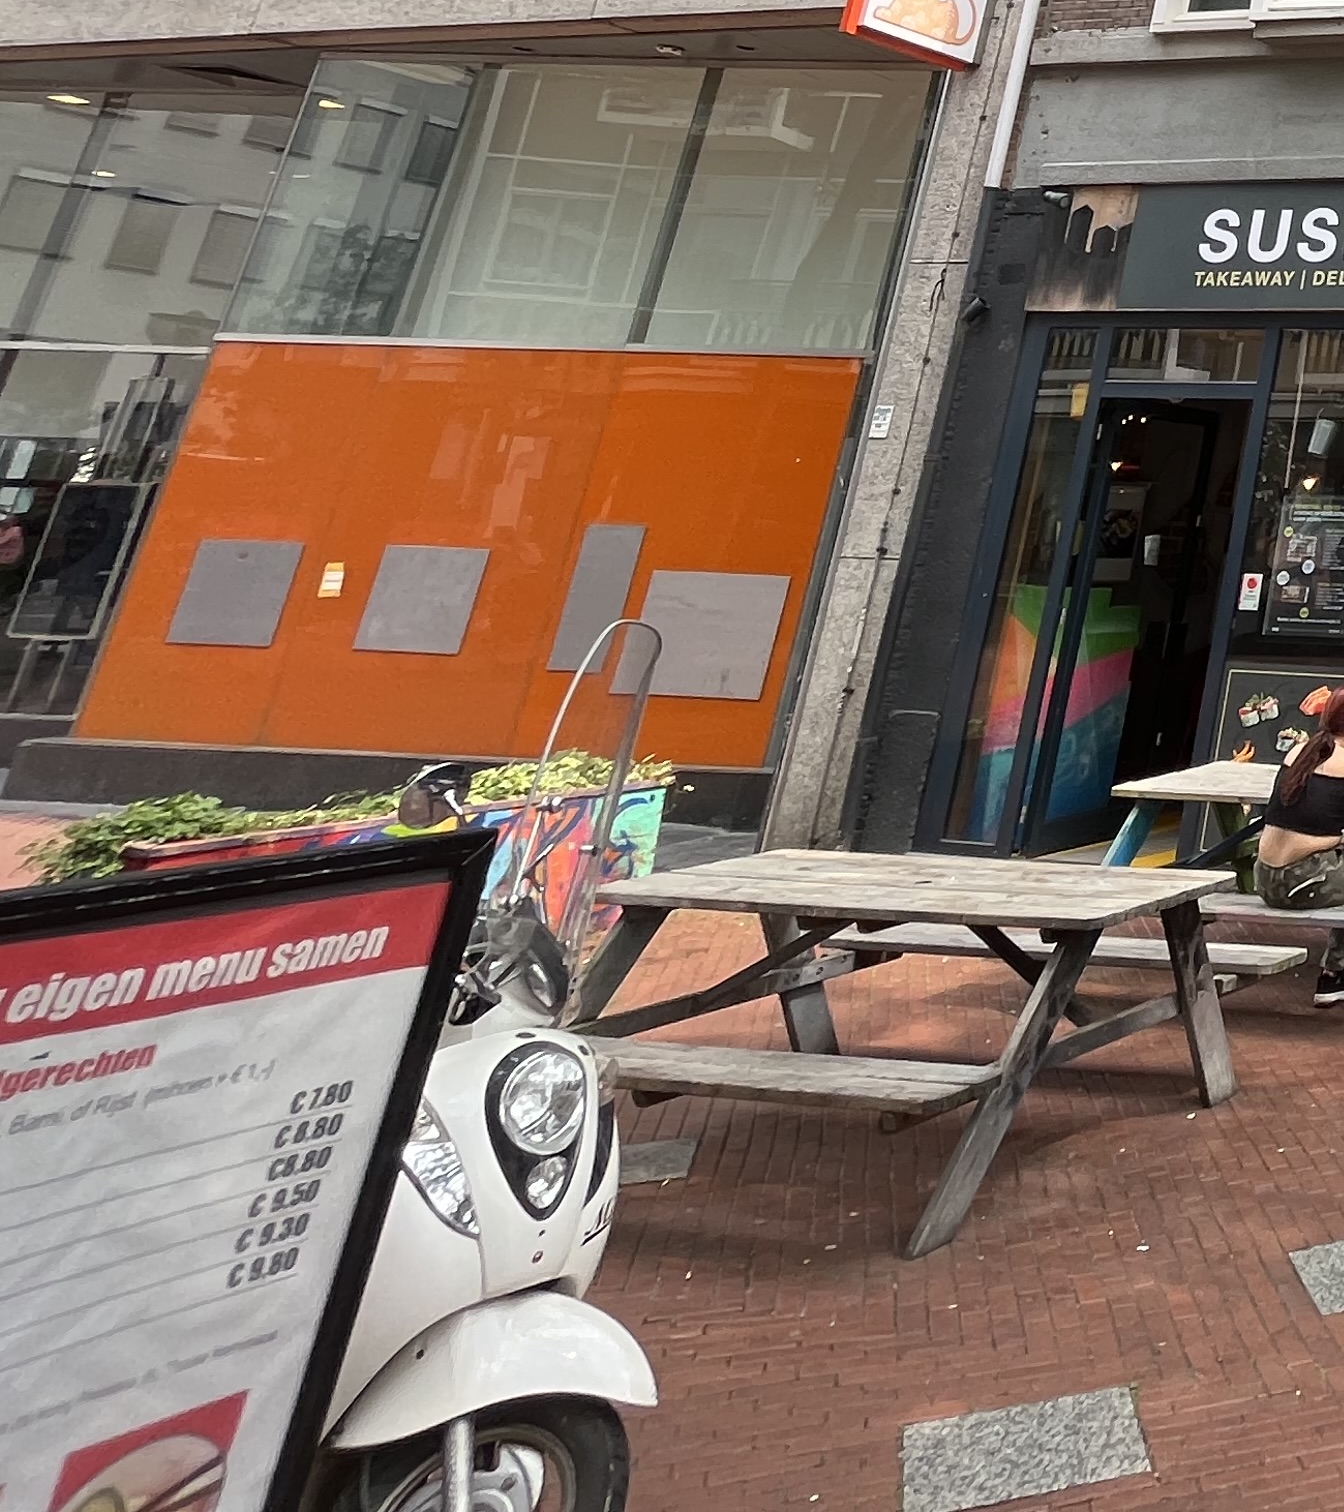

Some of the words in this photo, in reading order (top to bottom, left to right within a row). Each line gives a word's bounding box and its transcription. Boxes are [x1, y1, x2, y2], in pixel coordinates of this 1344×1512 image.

[1194, 270, 1296, 287] TAKEAWAY
[5, 968, 146, 1023] eigen
[145, 947, 269, 1002] menu
[266, 925, 390, 978] samen
